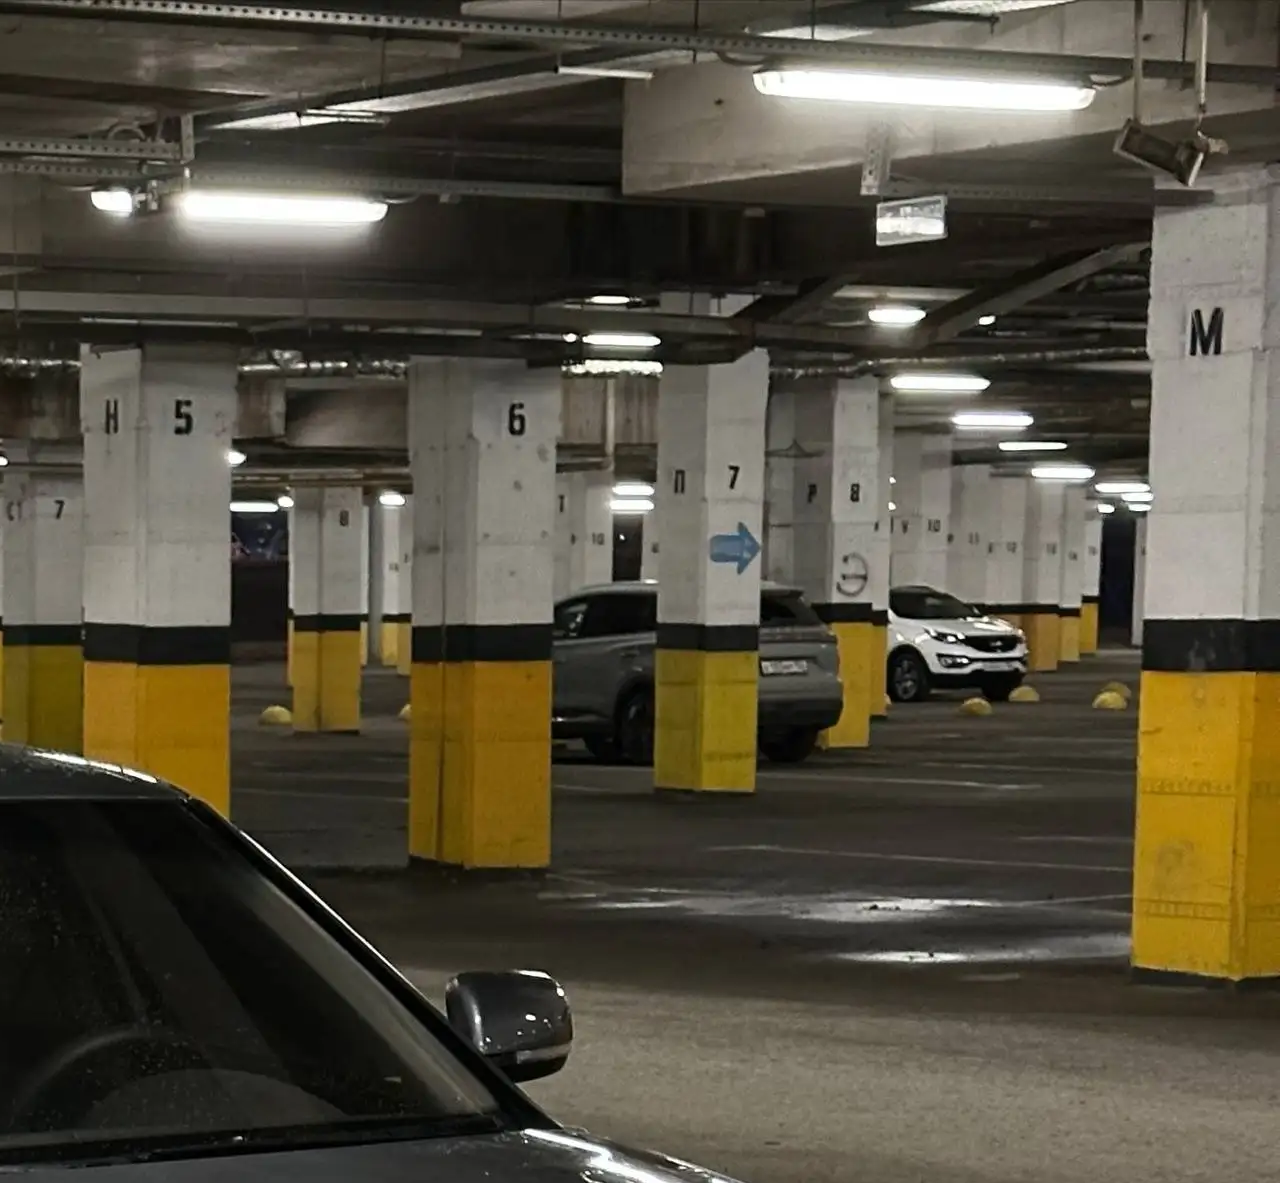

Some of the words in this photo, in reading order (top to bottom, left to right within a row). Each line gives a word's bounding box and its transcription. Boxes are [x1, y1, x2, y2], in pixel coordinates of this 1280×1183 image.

[174, 400, 192, 435] 5
[508, 403, 526, 436] 6
[728, 466, 740, 489] 7
[850, 483, 860, 502] 8
[54, 500, 65, 519] 7
